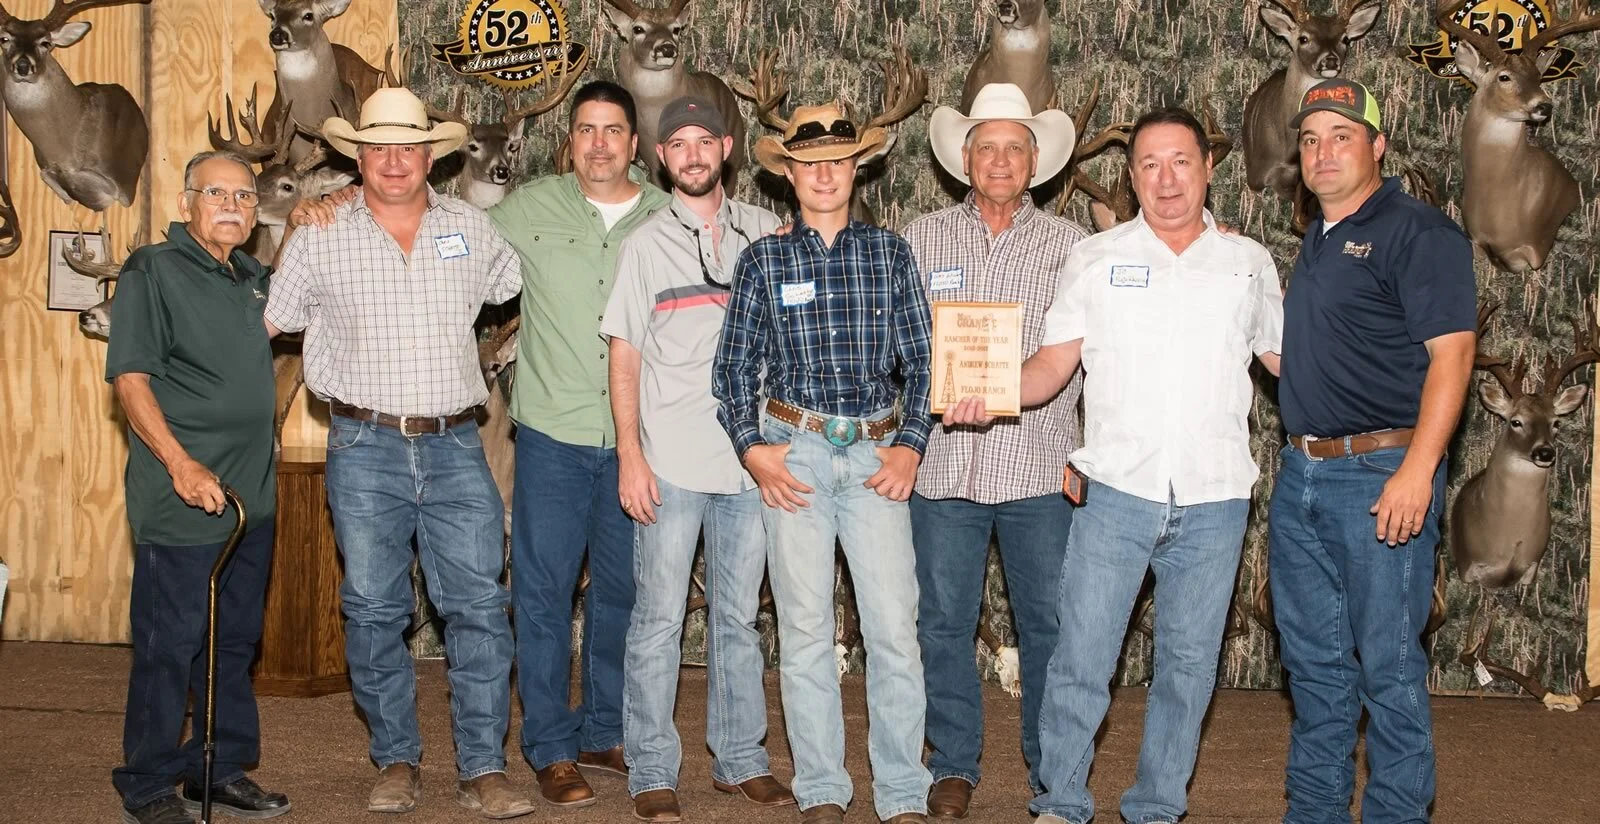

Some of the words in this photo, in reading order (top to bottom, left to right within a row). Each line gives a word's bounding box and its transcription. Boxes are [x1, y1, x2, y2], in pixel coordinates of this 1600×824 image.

[462, 43, 573, 72] Anniversary
[944, 335, 970, 343] RANCHER
[980, 336, 992, 344] THE
[993, 336, 1009, 344] YEAR
[959, 360, 983, 369] ANDREW
[984, 360, 1010, 369] SCHATTE
[960, 385, 981, 394] FLOJO
[982, 386, 1006, 395] RANCH
